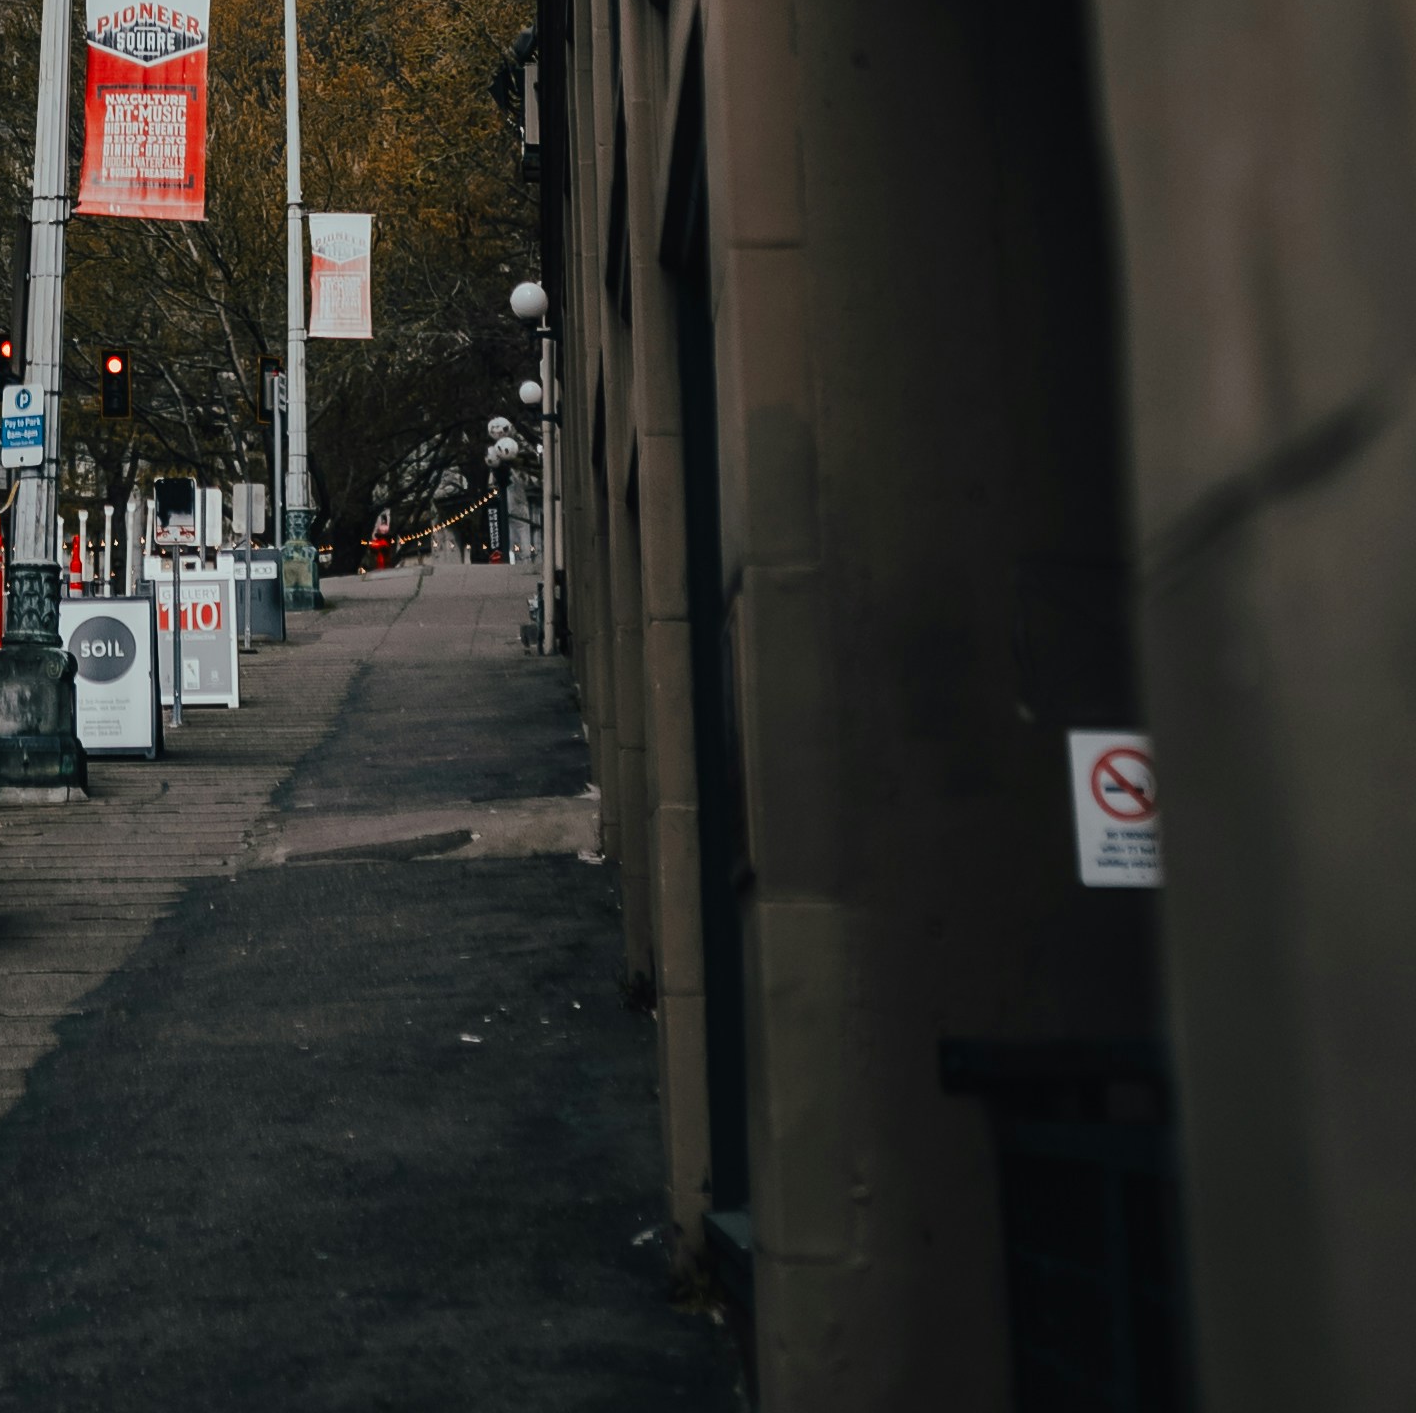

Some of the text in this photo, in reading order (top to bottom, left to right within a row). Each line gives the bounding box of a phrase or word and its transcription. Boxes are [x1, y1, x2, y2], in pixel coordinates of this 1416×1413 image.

[96, 2, 202, 38] PIONEER
[116, 31, 176, 52] SQUARE
[4, 419, 16, 430] Pay
[25, 417, 41, 428] Park
[163, 586, 218, 600] GLLERY
[160, 601, 219, 632] 110
[80, 638, 125, 658] SOIL
